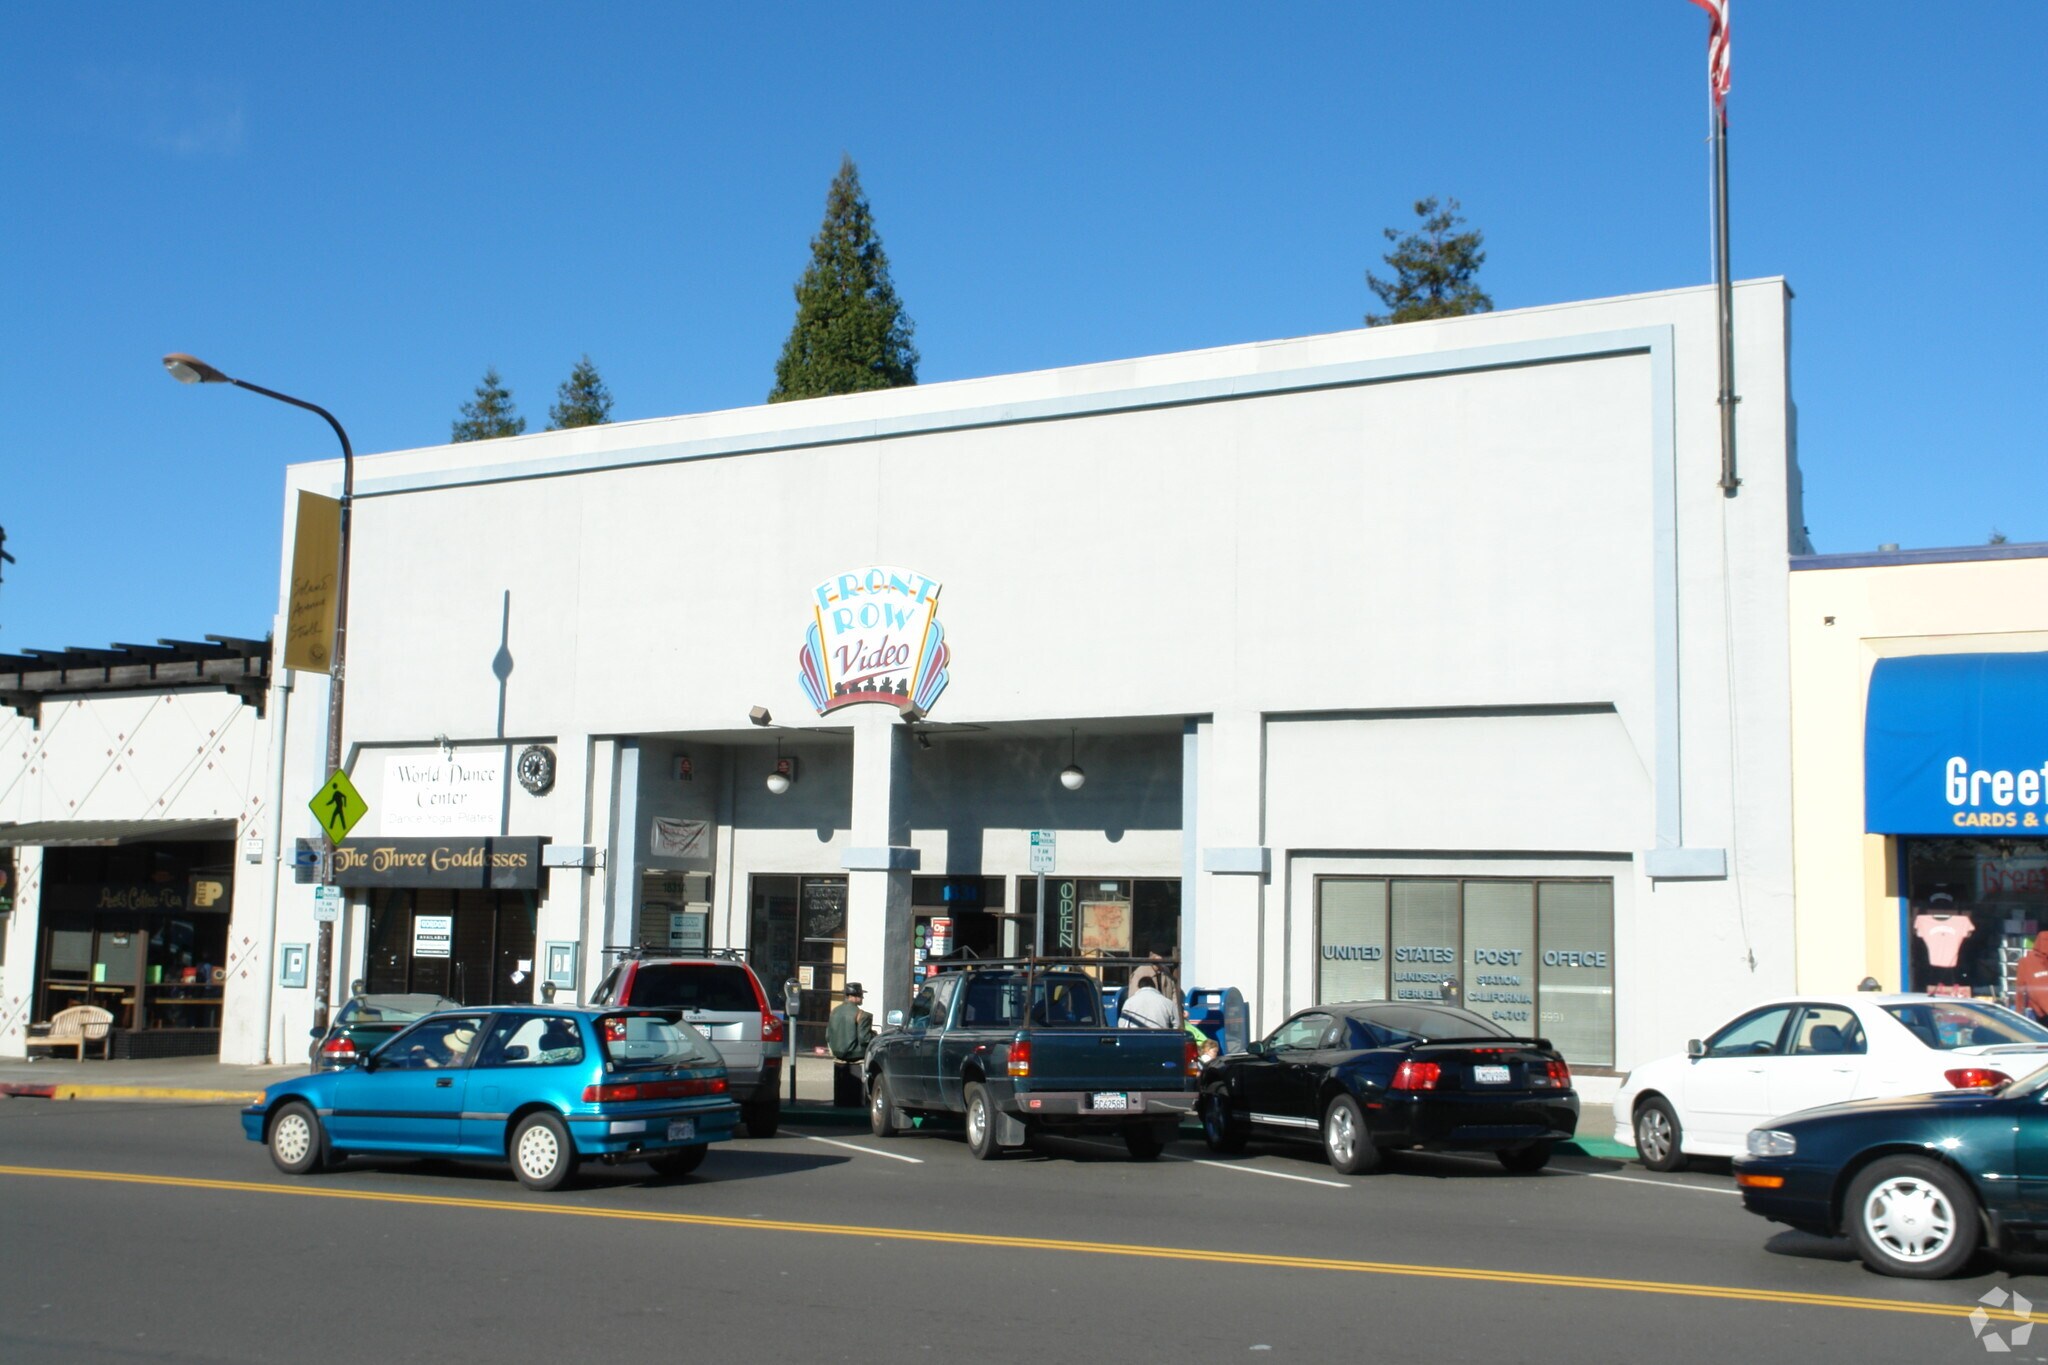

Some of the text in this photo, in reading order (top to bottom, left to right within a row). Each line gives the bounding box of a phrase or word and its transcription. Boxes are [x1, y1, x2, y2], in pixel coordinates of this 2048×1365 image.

[816, 568, 938, 611] FRONT
[832, 602, 915, 635] ROW
[833, 634, 910, 676] Video
[395, 764, 496, 785] World Dance
[416, 788, 468, 808] Center
[458, 812, 496, 824] Pilates
[1953, 812, 2018, 827] CARDS
[2023, 812, 2039, 827] &
[335, 846, 528, 872] The Three Goddesses
[421, 920, 448, 929] GORDON
[1059, 881, 1075, 949] OPEN
[1322, 945, 1607, 968] UNITED STATES POST OFFICE
[1394, 972, 1520, 986] LANDSCAPE STATION
[1467, 990, 1533, 1005] CALIFORNIA
[1492, 1010, 1530, 1022] 94707
